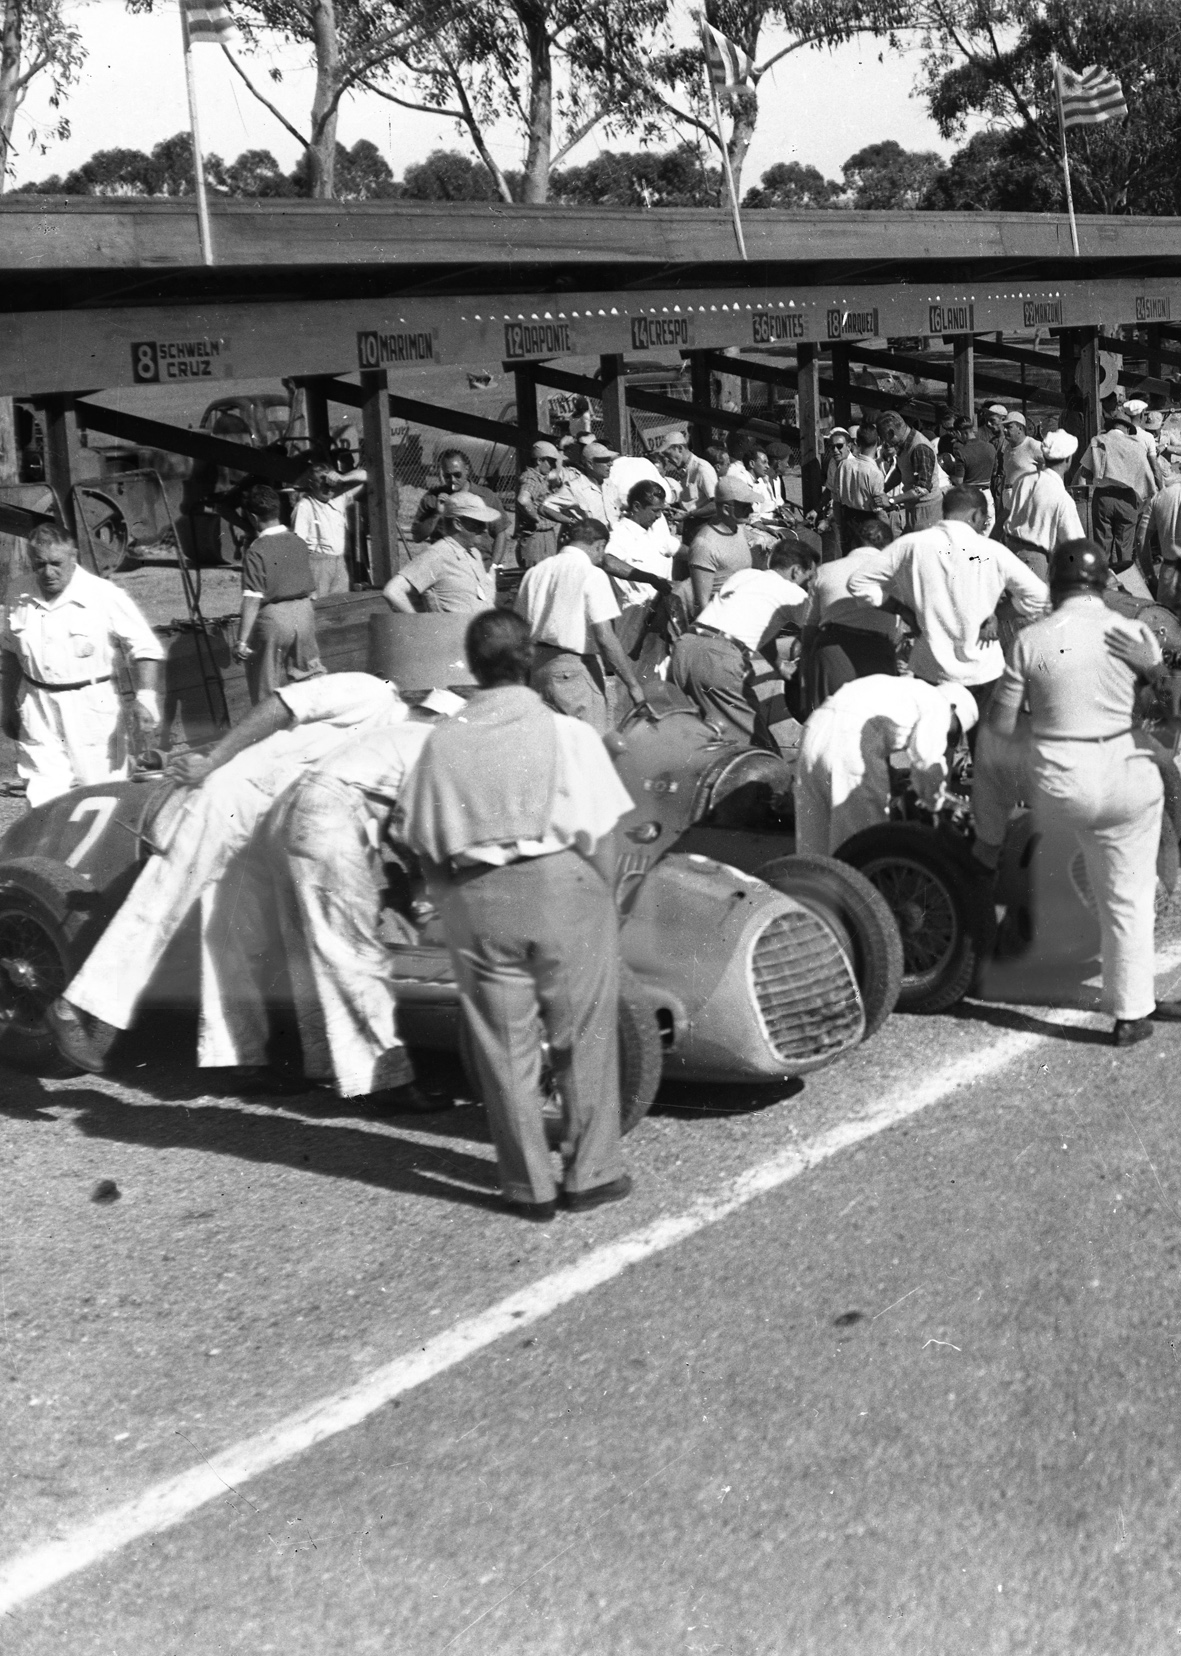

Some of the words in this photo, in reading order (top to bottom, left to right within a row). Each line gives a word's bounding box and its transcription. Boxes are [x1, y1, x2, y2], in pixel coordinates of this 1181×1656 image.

[634, 320, 648, 347] 14
[649, 318, 688, 345] CRESPO
[753, 315, 769, 340] 36
[769, 314, 804, 339] FONTES
[829, 312, 840, 336] 18
[931, 309, 941, 331] 16
[942, 307, 967, 330] LANDI
[159, 341, 220, 359] SCHWELM
[361, 335, 378, 365] 10
[379, 333, 433, 362] MARIMON
[507, 326, 523, 355] 12
[524, 324, 570, 354] DAPONTE
[137, 344, 155, 379] 8
[166, 360, 213, 378] CRUZ
[65, 796, 118, 868] 7
